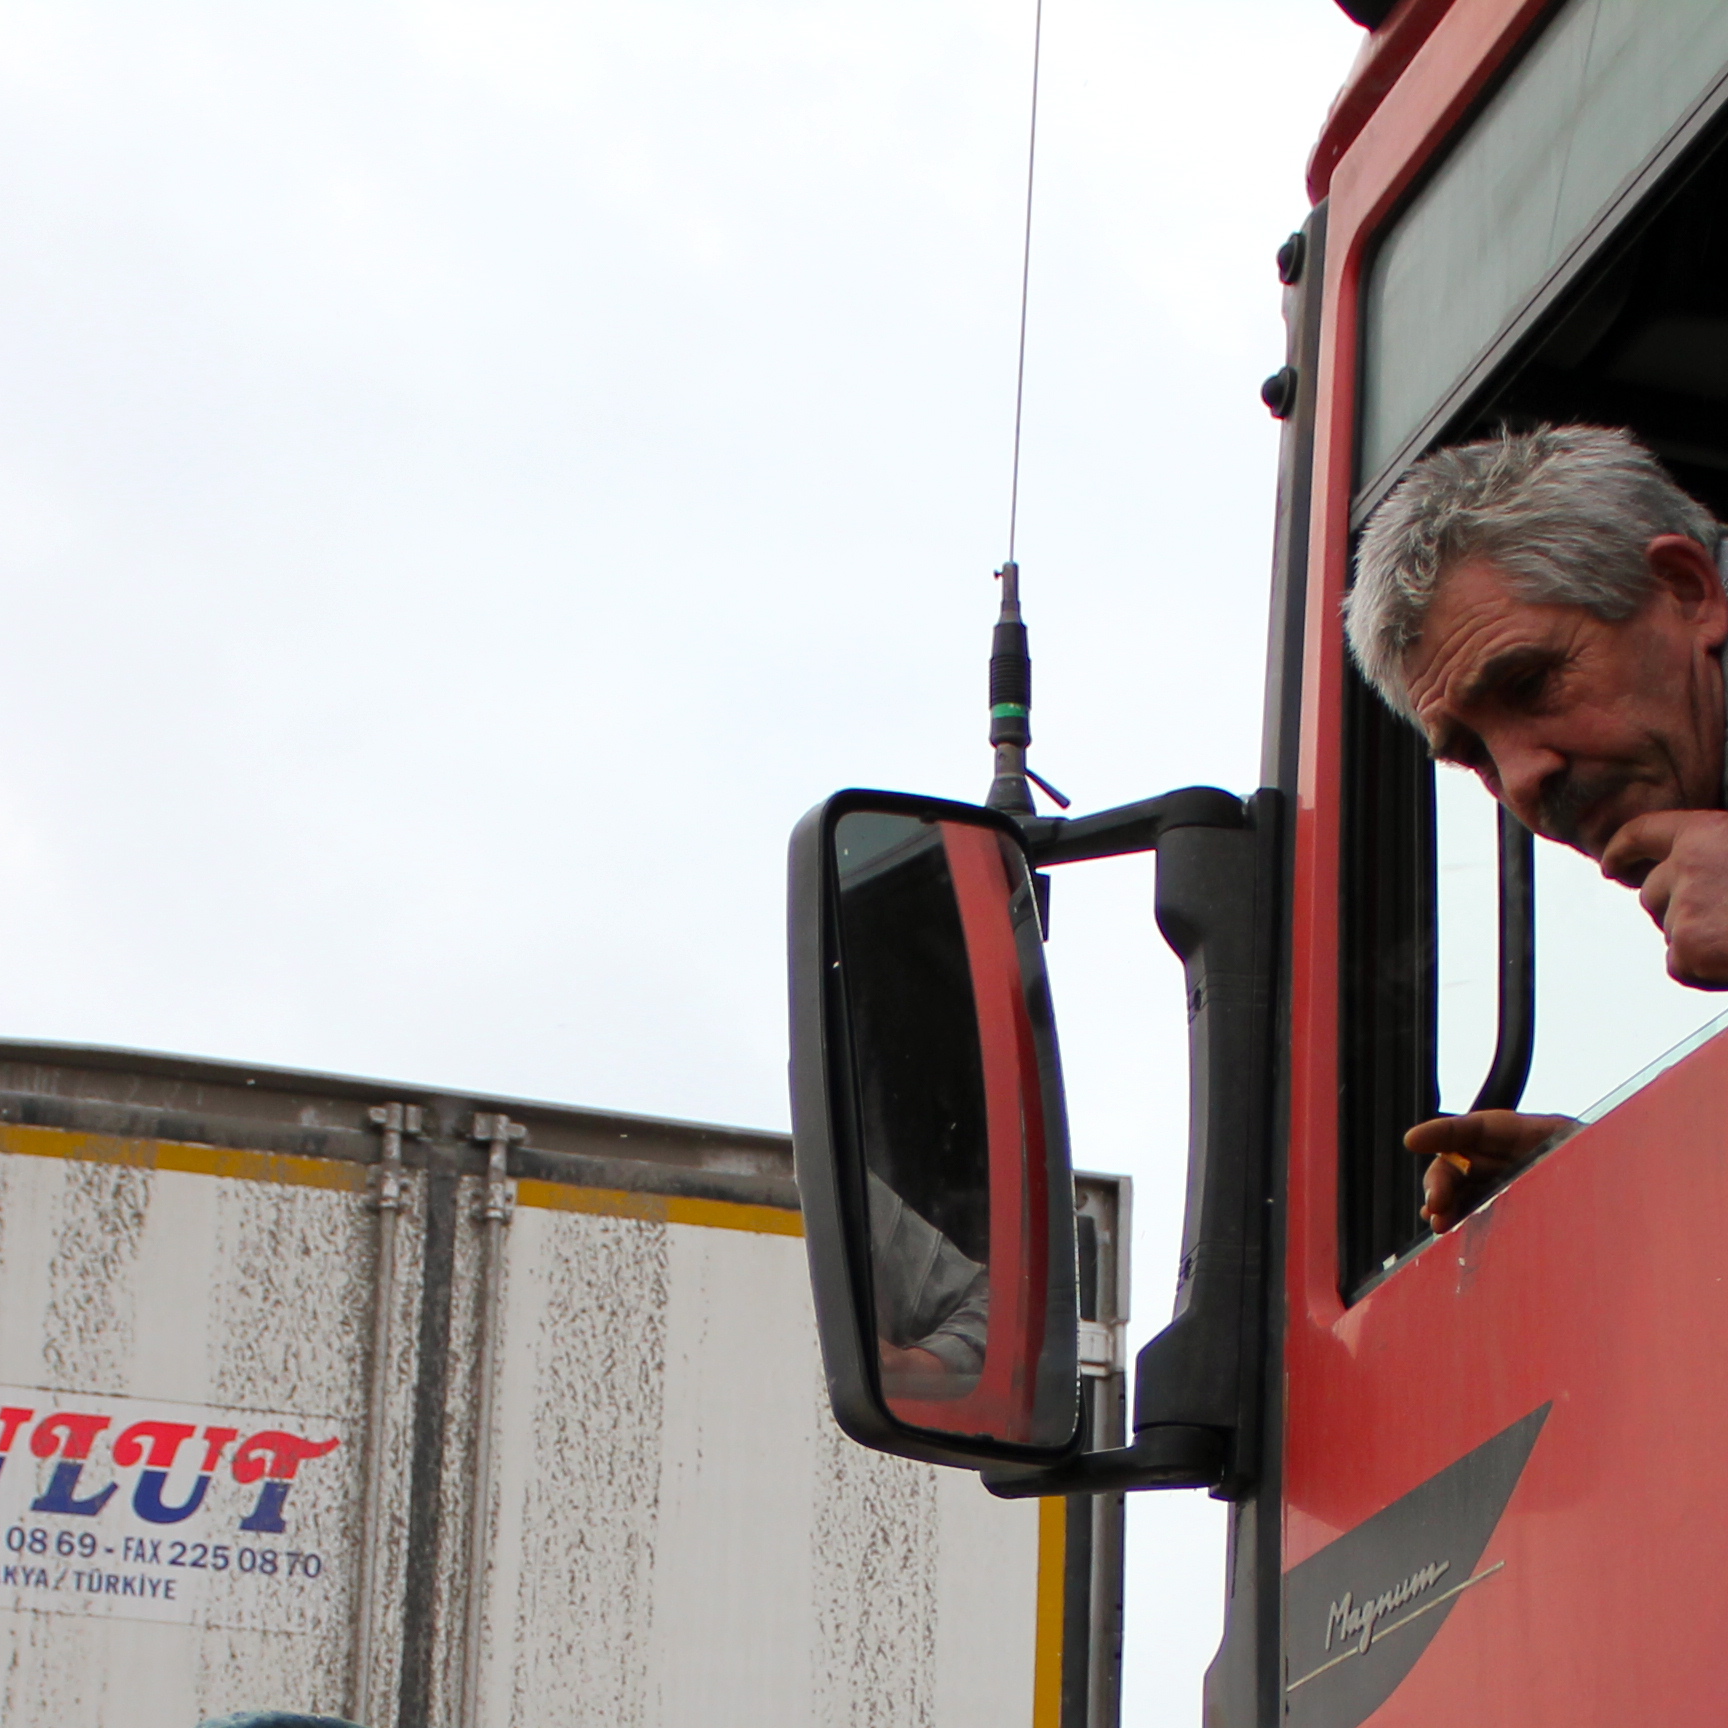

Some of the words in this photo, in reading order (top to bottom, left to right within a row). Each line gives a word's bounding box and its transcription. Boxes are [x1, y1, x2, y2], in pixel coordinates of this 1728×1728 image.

[123, 1536, 162, 1564] FAX
[73, 1568, 176, 1599] TÜRKİYE
[1325, 1558, 1451, 1655] Magnum
